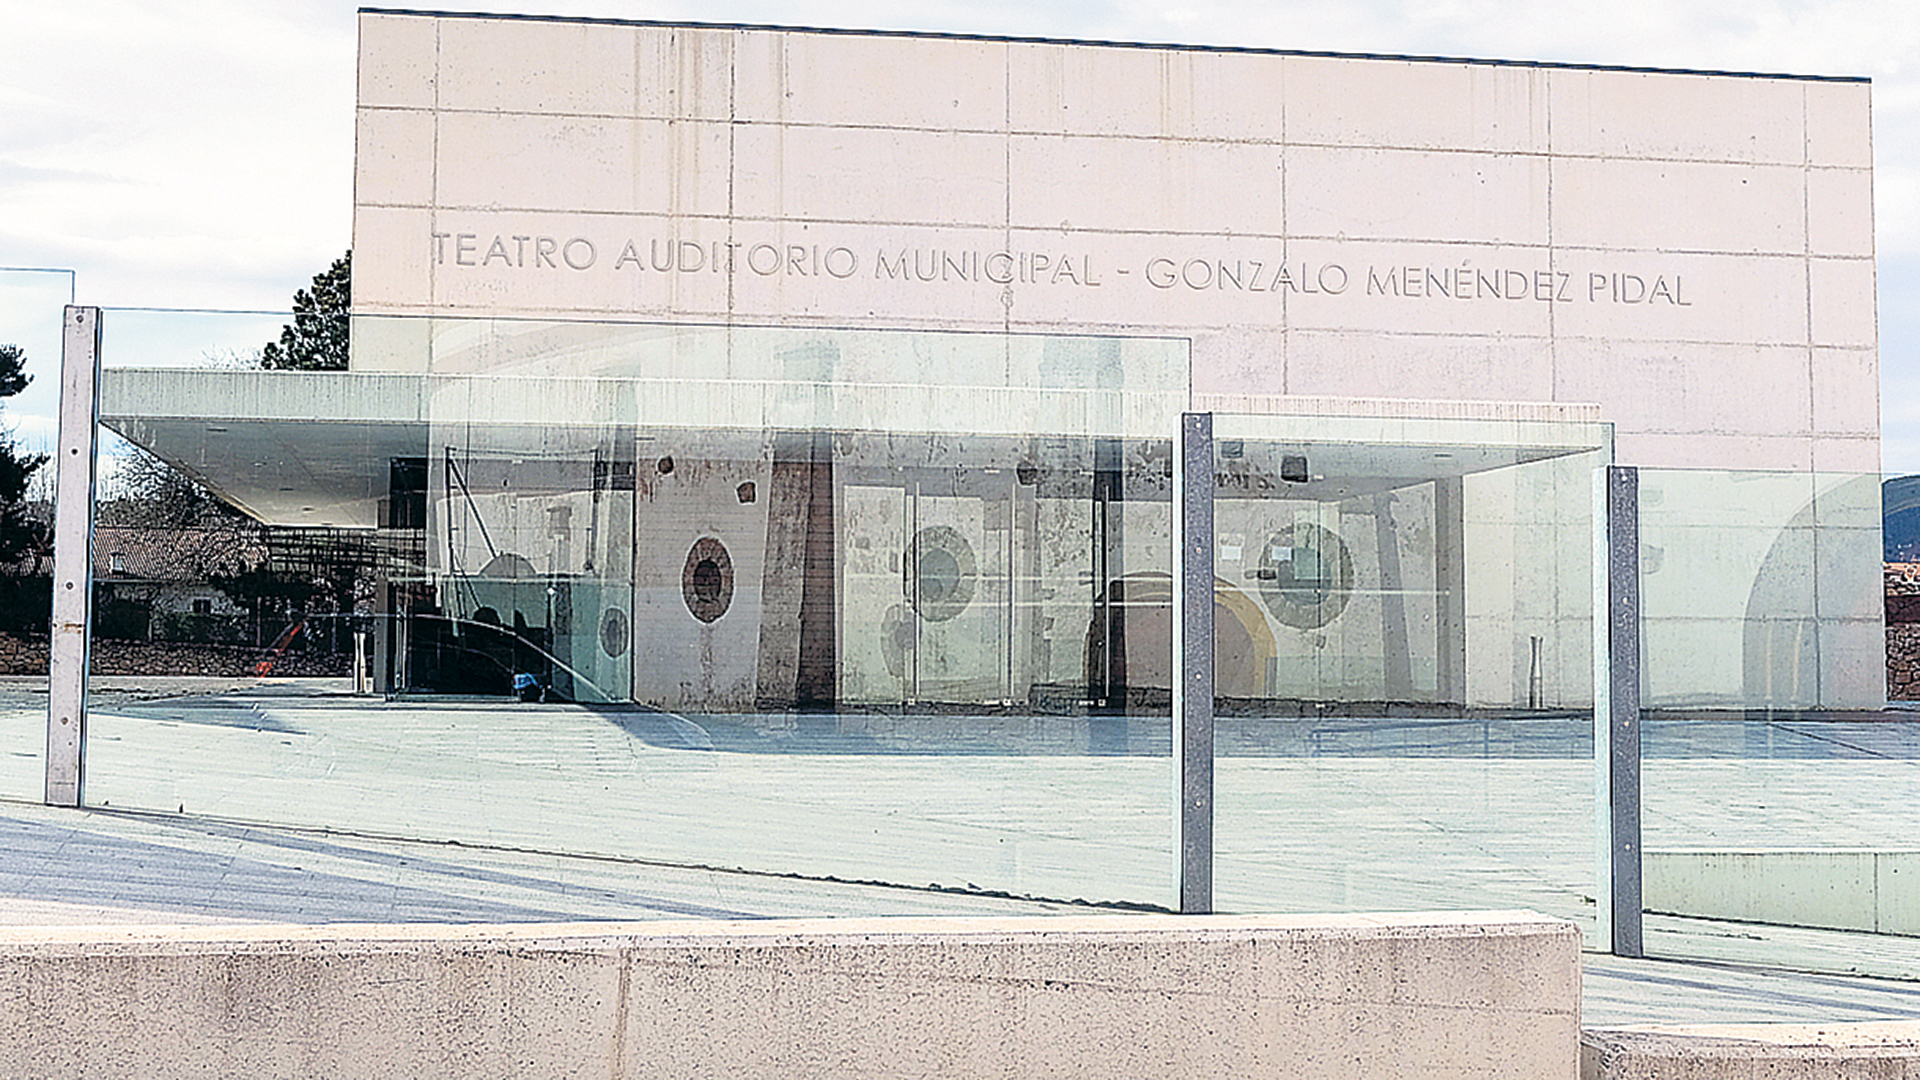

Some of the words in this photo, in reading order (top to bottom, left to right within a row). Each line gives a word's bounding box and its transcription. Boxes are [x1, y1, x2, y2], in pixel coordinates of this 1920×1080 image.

[433, 232, 598, 271] TEATRO
[614, 238, 859, 279] AUDITORIO
[874, 248, 1102, 287] MUNICIPAL
[1145, 256, 1349, 295] GONZALO
[1366, 258, 1573, 303] MENÉNDEZ
[1588, 272, 1692, 306] PIDAL
